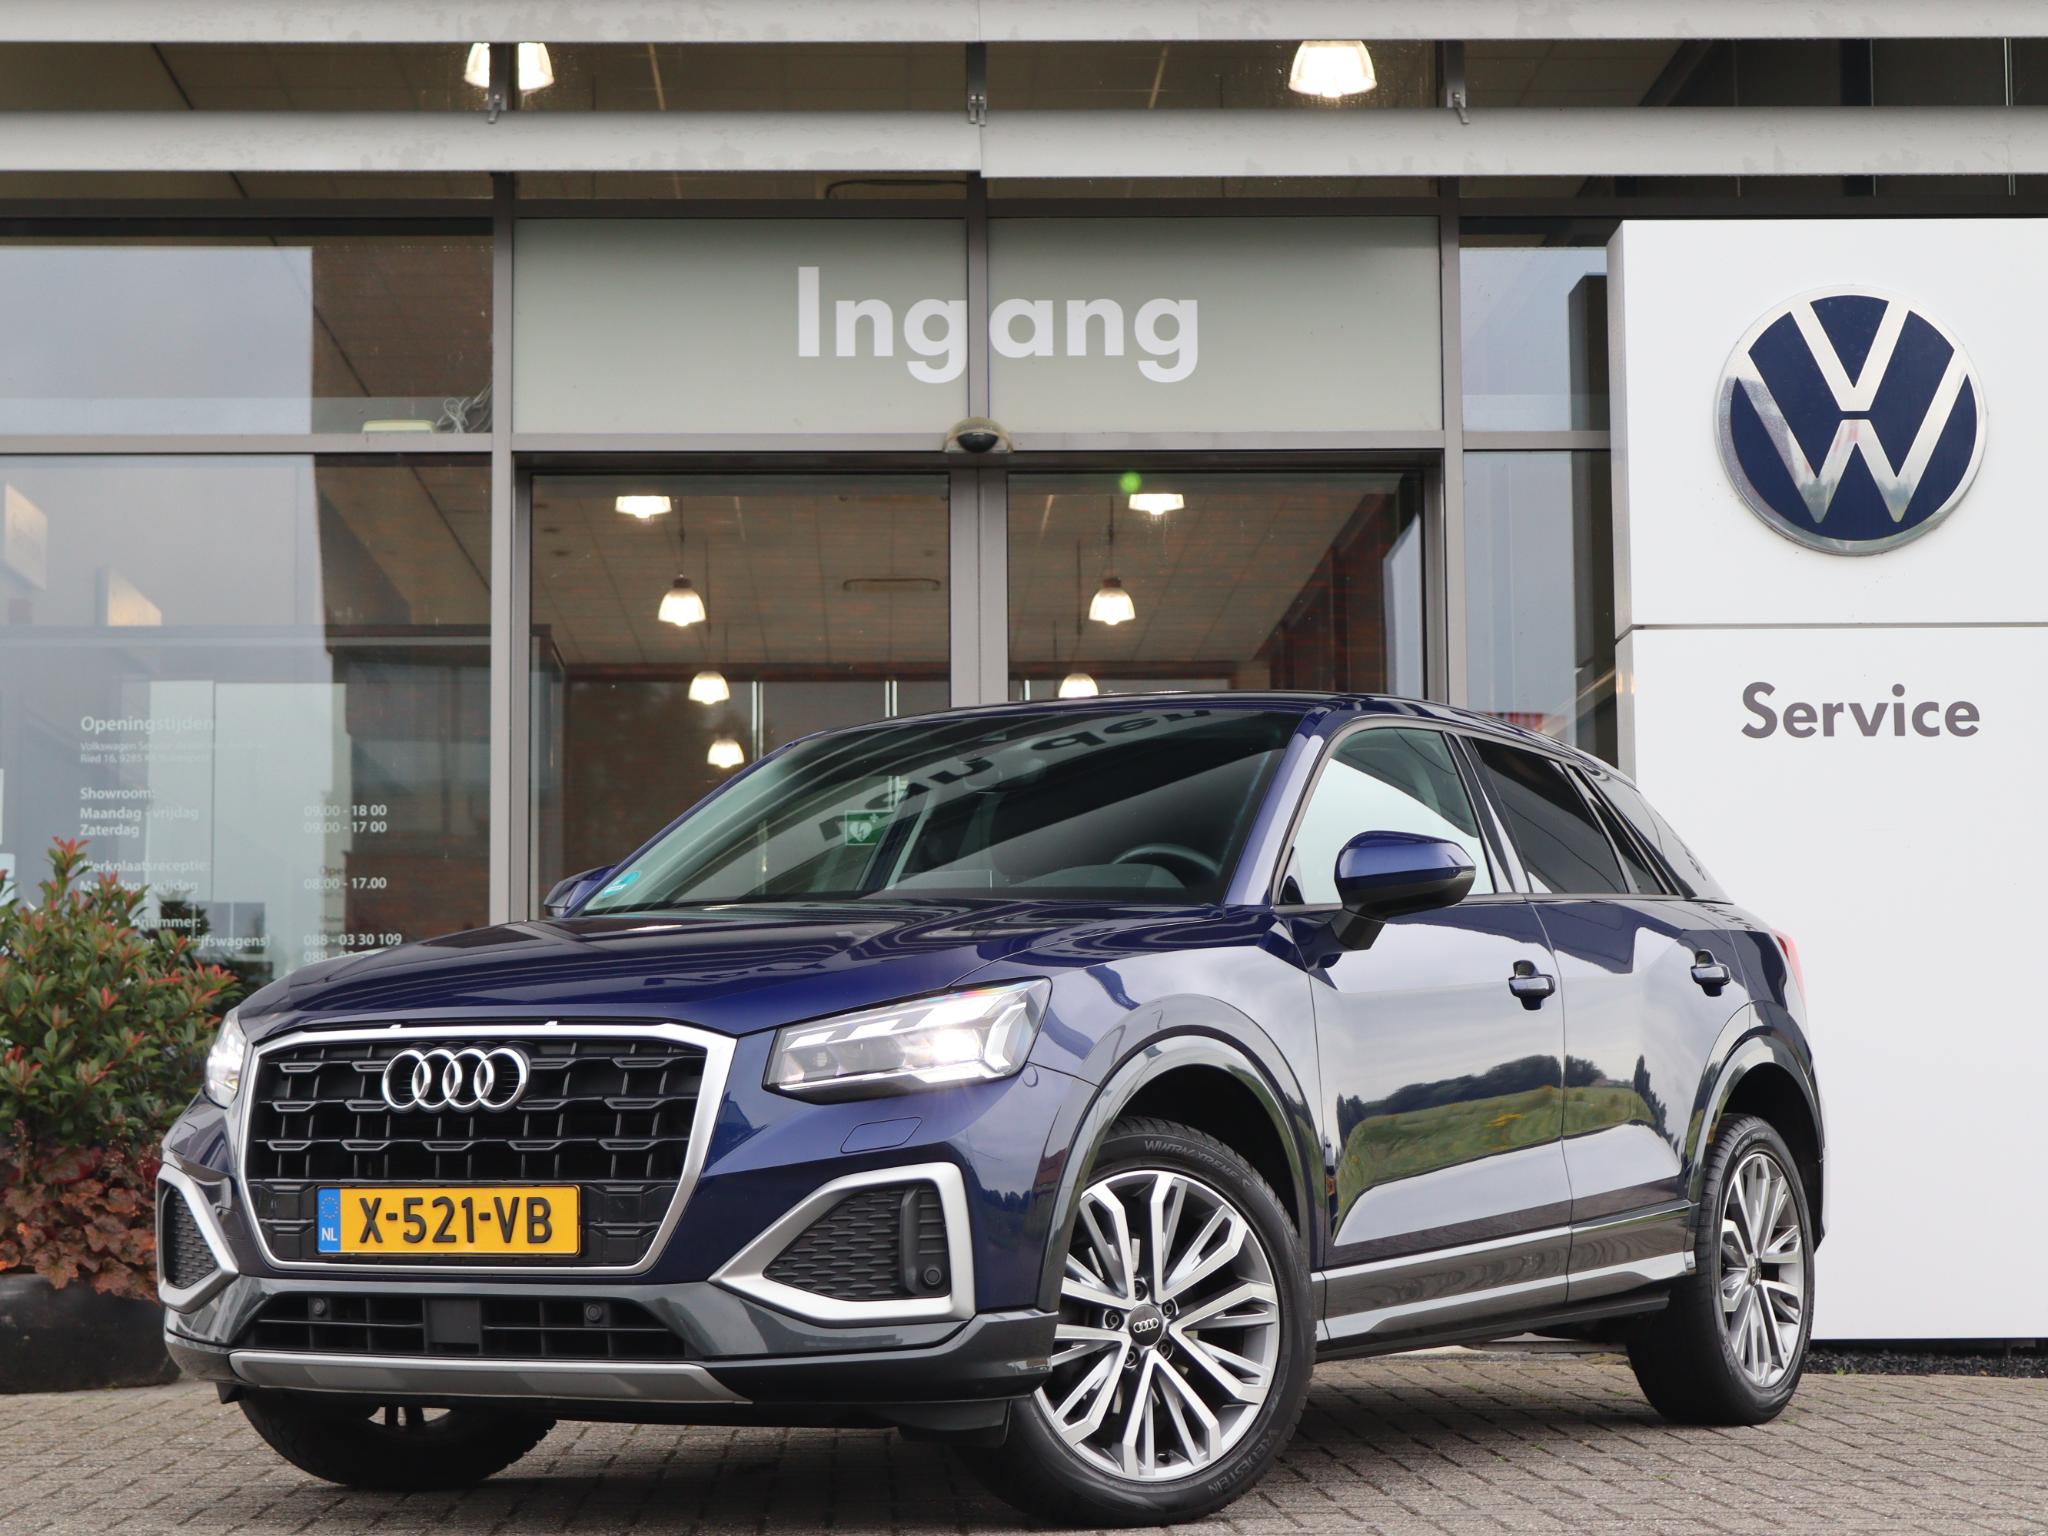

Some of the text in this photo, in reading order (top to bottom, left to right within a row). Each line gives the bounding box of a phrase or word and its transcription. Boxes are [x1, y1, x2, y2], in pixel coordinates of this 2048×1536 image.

[797, 265, 1199, 383] Ingang
[1741, 681, 1981, 739] Service
[80, 715, 214, 735] Openingstijden
[80, 807, 142, 822] Maandag
[152, 806, 199, 822] vrijdag
[80, 823, 140, 838] Zaterdag
[304, 879, 340, 889] 08.00
[352, 877, 387, 889] 17.00
[304, 935, 328, 946] 088
[339, 934, 356, 946] 03
[358, 934, 375, 945] 30
[379, 933, 402, 946] 109
[358, 1195, 553, 1244] X-521-VB
[321, 1226, 338, 1242] NL
